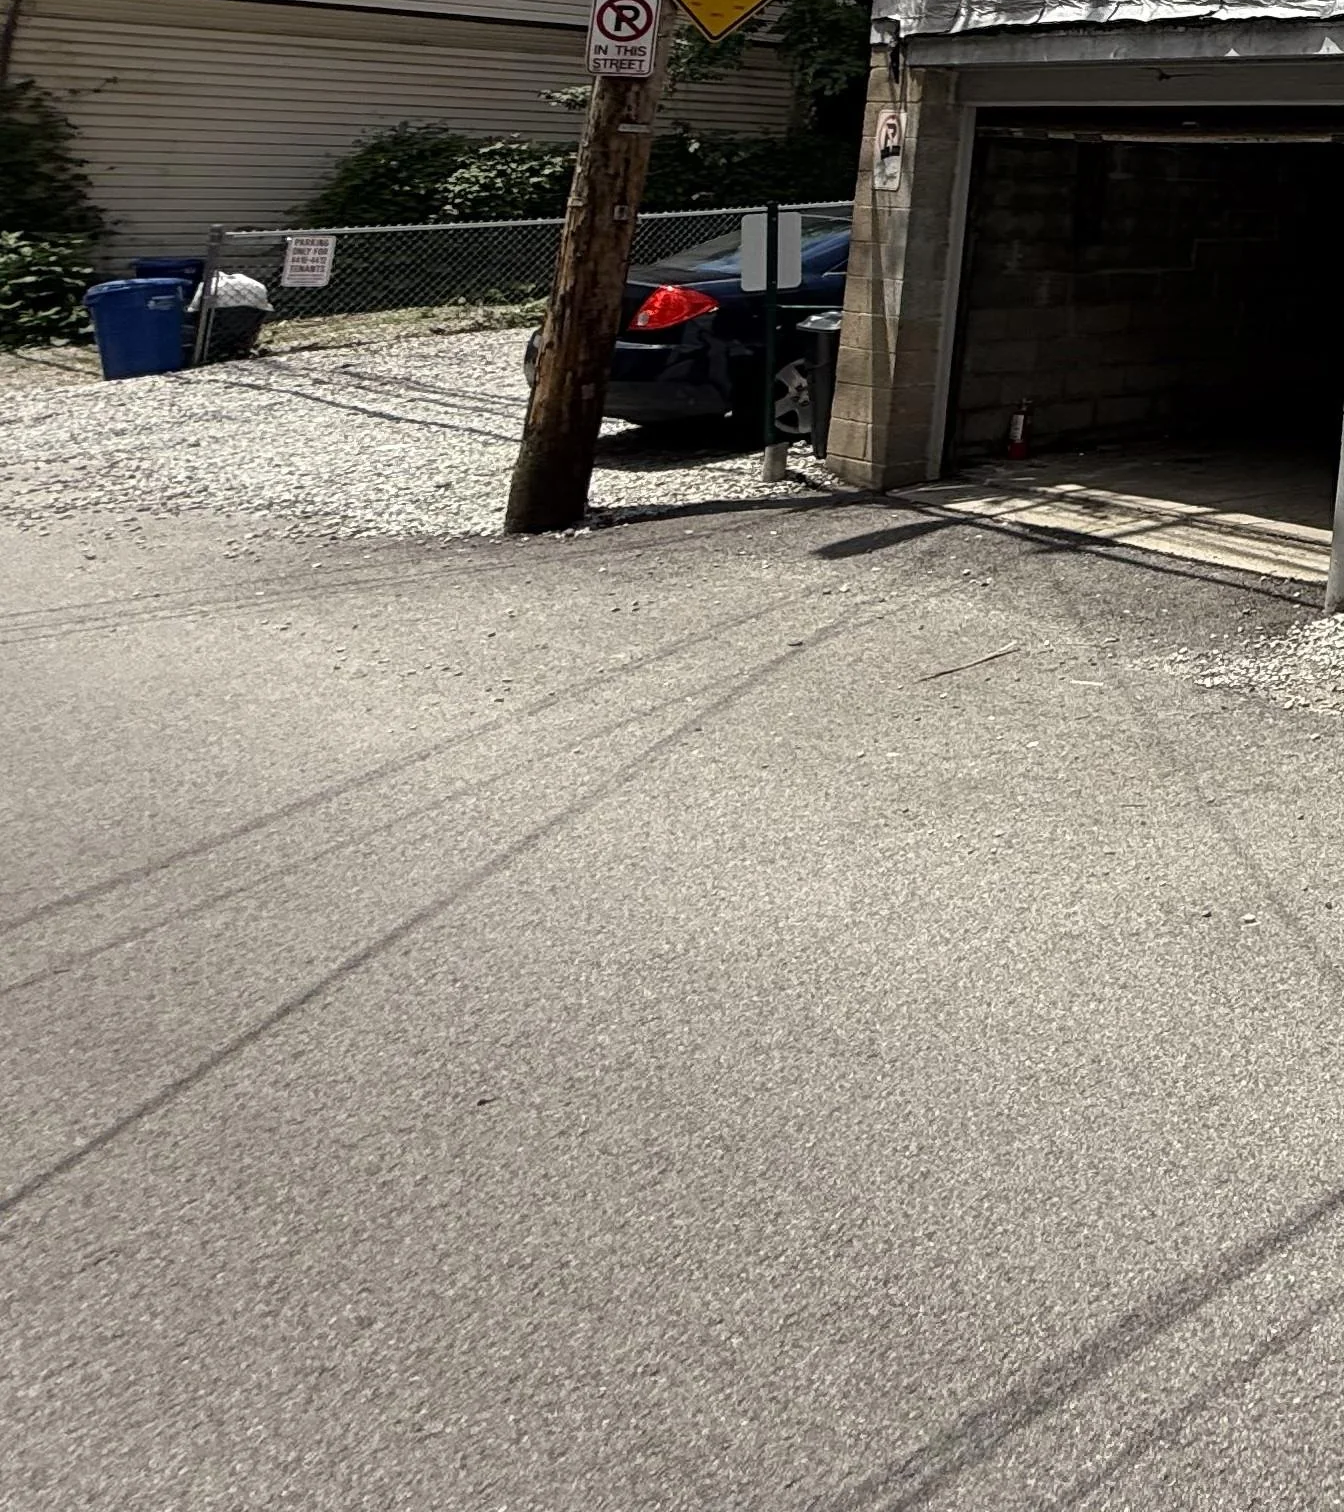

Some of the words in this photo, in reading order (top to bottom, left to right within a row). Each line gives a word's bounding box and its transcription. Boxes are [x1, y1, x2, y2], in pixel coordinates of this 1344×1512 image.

[594, 44, 609, 56] IN
[615, 45, 648, 57] THIS
[592, 58, 646, 70] STREET
